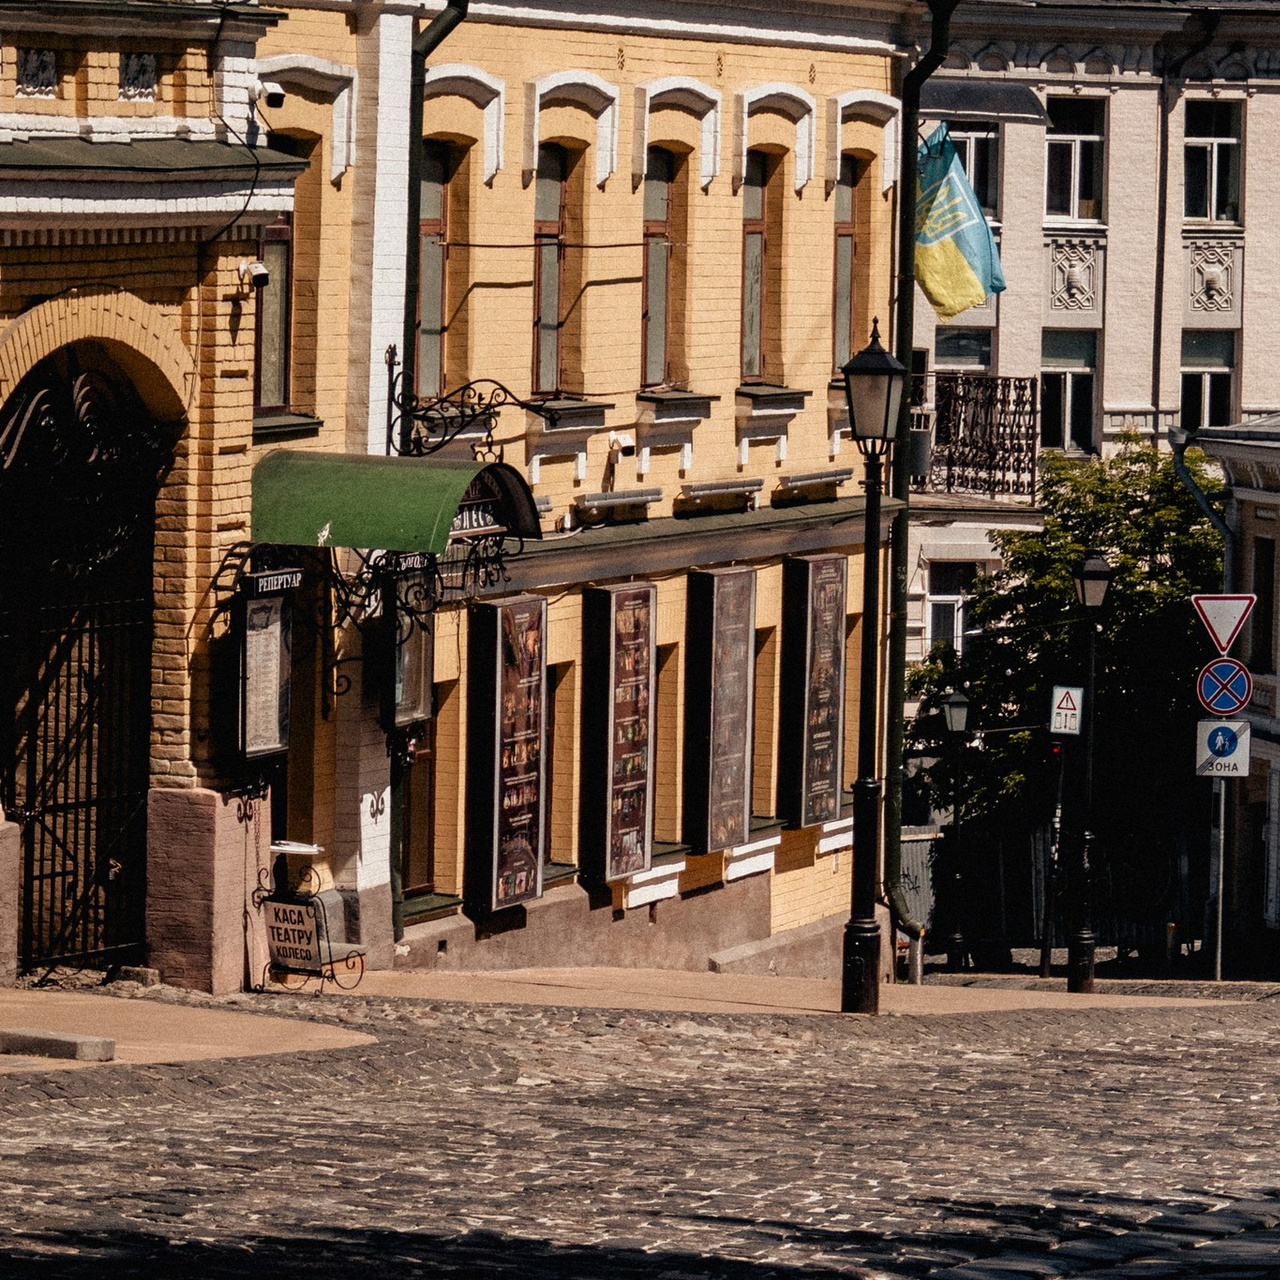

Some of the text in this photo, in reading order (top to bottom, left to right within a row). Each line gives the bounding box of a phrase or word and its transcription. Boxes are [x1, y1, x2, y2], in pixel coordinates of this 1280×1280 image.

[450, 504, 495, 531] ОЛЕСО
[258, 572, 302, 593] РЕПЕРТУАР
[1207, 761, 1239, 772] ЗОНА
[273, 907, 305, 926] КАСА
[269, 925, 313, 946] ТЕАТРУ
[275, 945, 312, 961] КОЛЕСО
